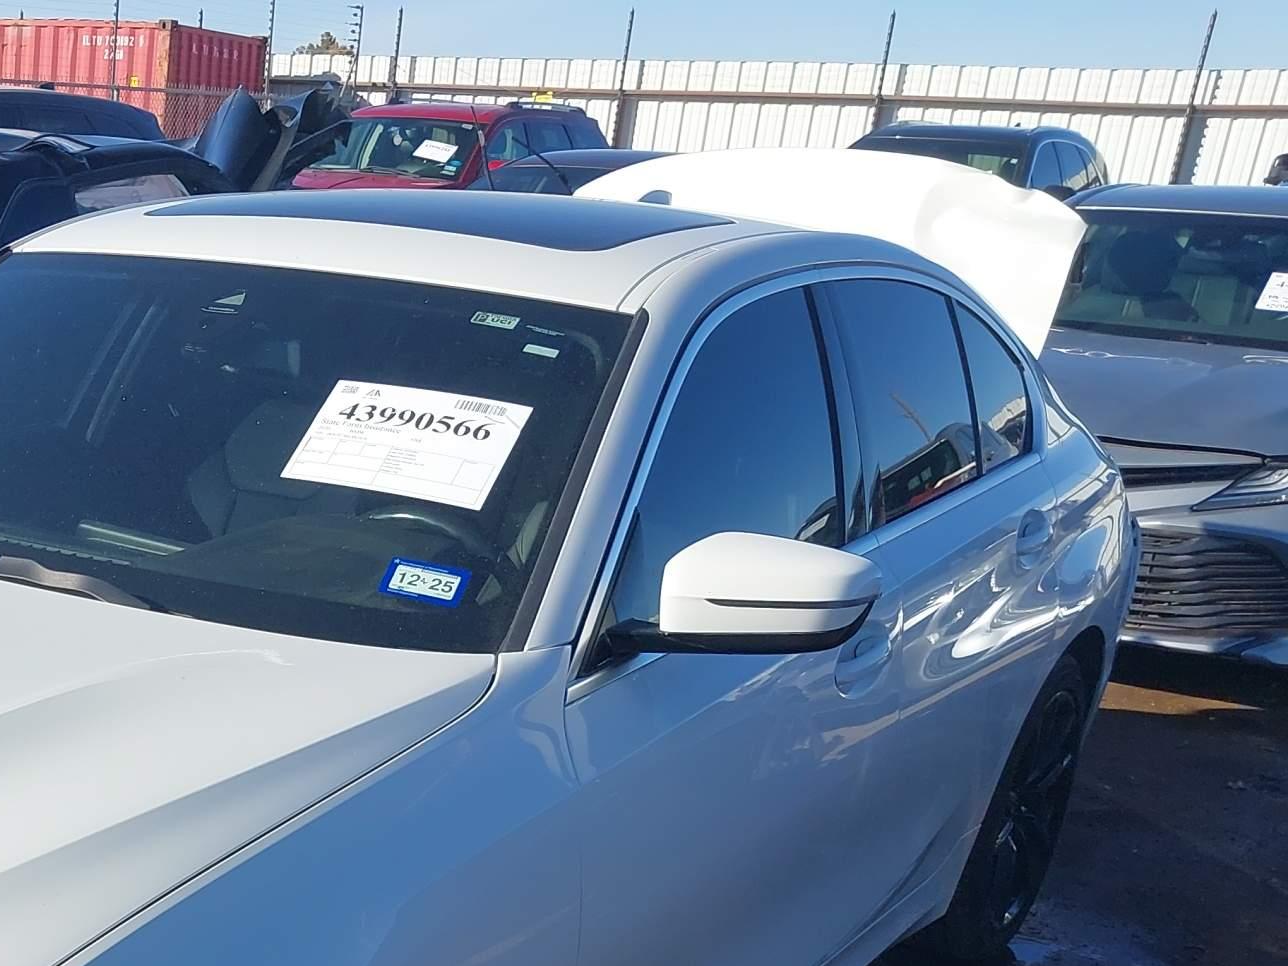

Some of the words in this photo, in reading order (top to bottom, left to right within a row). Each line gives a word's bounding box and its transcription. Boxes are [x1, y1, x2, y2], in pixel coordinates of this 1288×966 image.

[338, 403, 496, 441] 43990566
[398, 571, 421, 587] 12
[428, 577, 456, 594] 25
